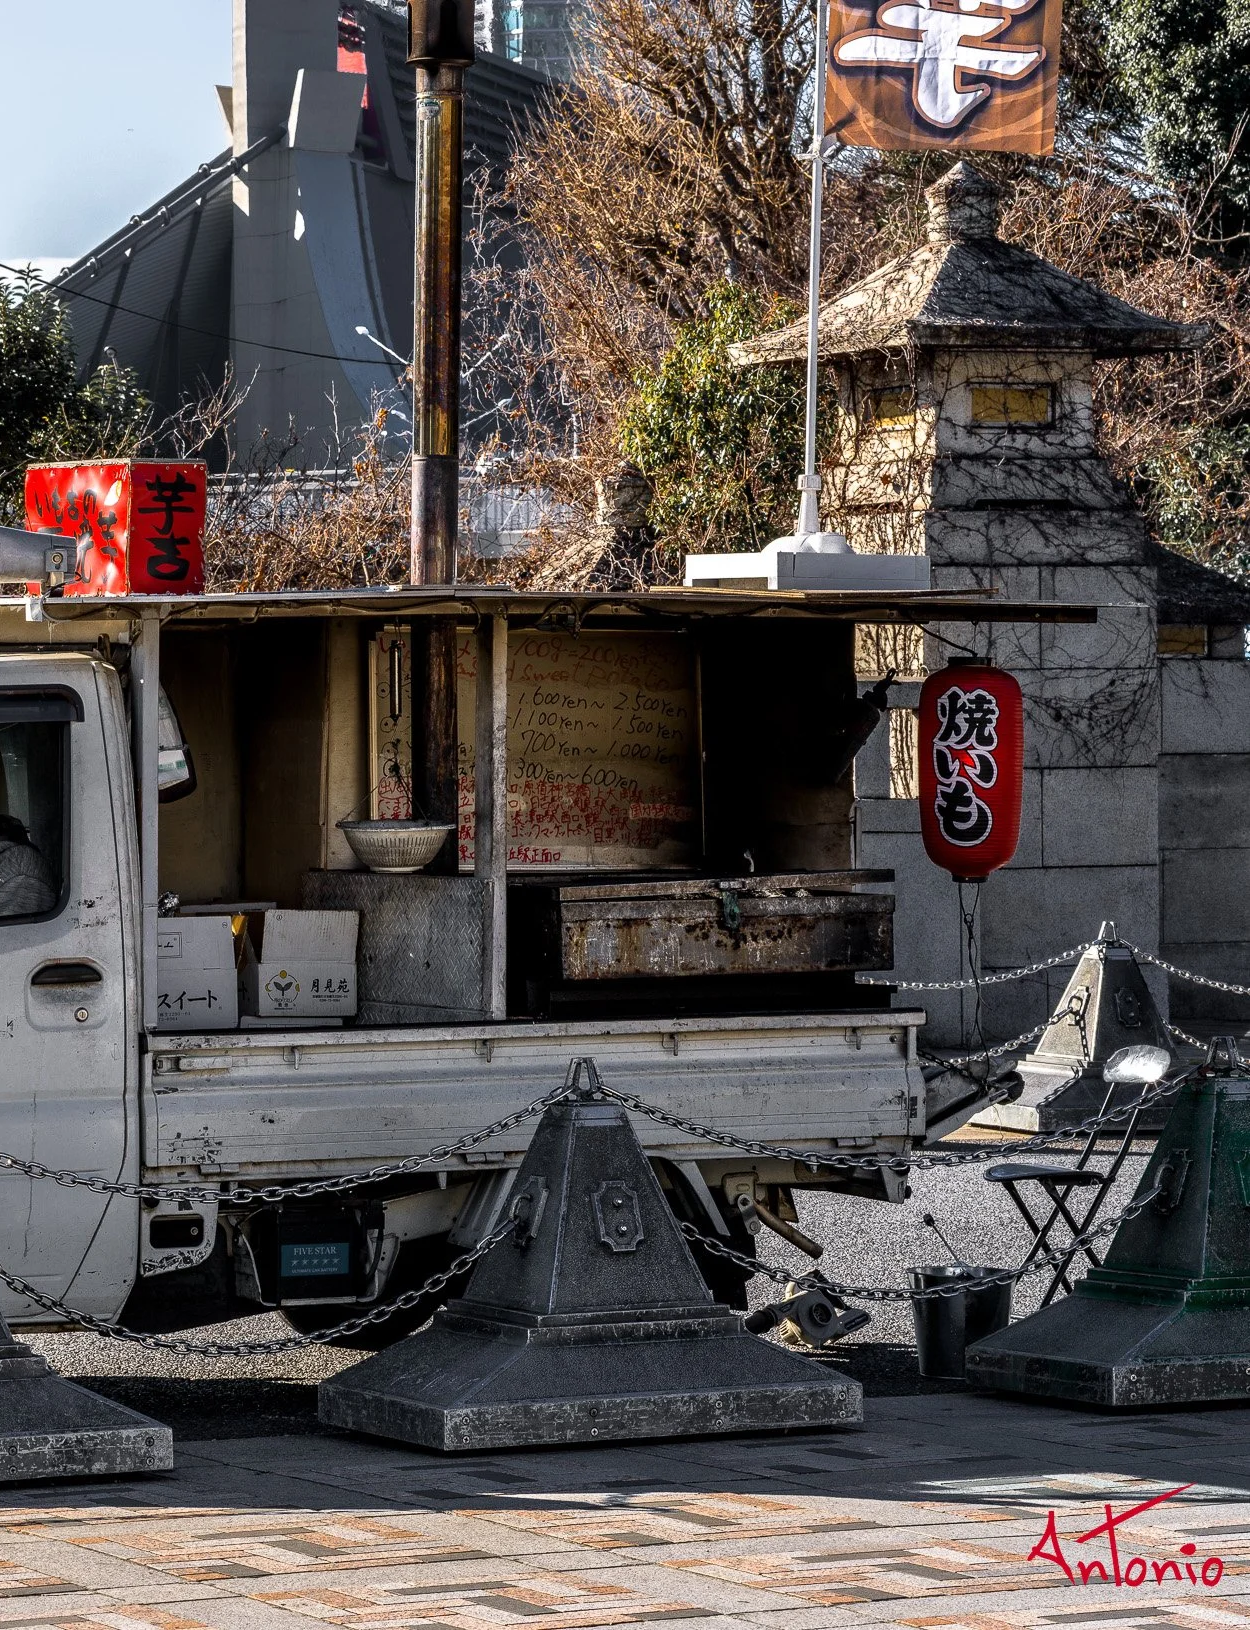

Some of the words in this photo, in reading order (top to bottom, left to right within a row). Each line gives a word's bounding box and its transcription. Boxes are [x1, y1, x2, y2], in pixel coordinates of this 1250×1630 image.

[933, 686, 998, 847] 焼いも
[310, 978, 350, 994] 月見苑
[293, 1248, 314, 1256] FIVE
[314, 1246, 337, 1255] STAR
